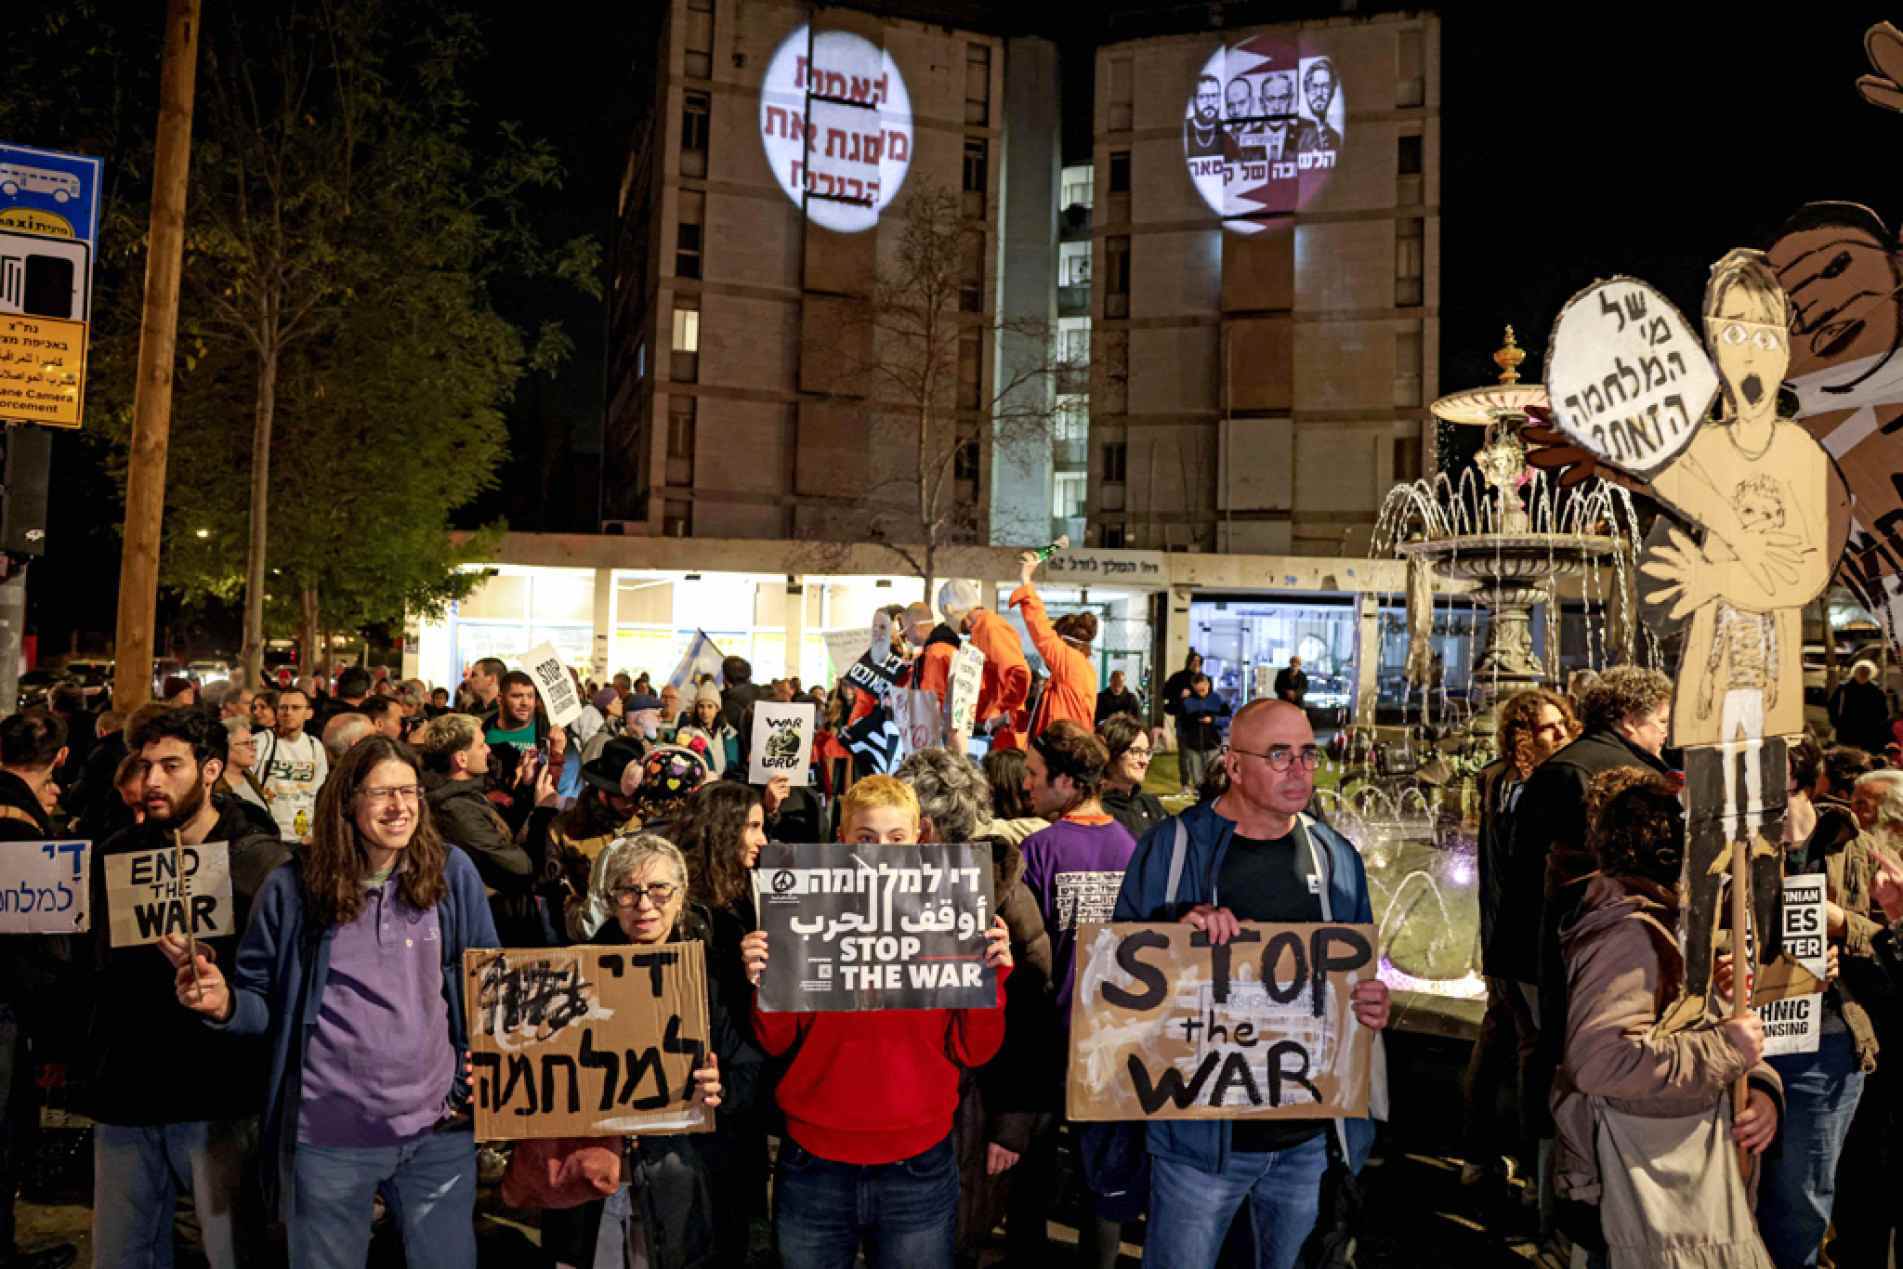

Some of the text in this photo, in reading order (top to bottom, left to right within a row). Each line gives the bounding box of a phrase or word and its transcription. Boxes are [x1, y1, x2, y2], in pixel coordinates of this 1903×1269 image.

[763, 104, 818, 152] את
[1598, 289, 1648, 334] של
[1639, 315, 1673, 347] מי
[26, 389, 73, 403] Camera
[1565, 351, 1687, 428] המלחמה
[131, 848, 200, 885] END
[150, 877, 192, 898] THE
[950, 867, 981, 893] די
[134, 895, 218, 939] WAR
[900, 896, 988, 940] أوقف
[839, 936, 921, 961] STOP
[597, 952, 680, 998] די
[840, 965, 903, 990] THE
[908, 962, 984, 988] WAR
[1101, 926, 1372, 1019] STOP
[1180, 1007, 1259, 1046] the
[471, 1013, 705, 1117] למלחמה
[1127, 1040, 1324, 1116] WAR
